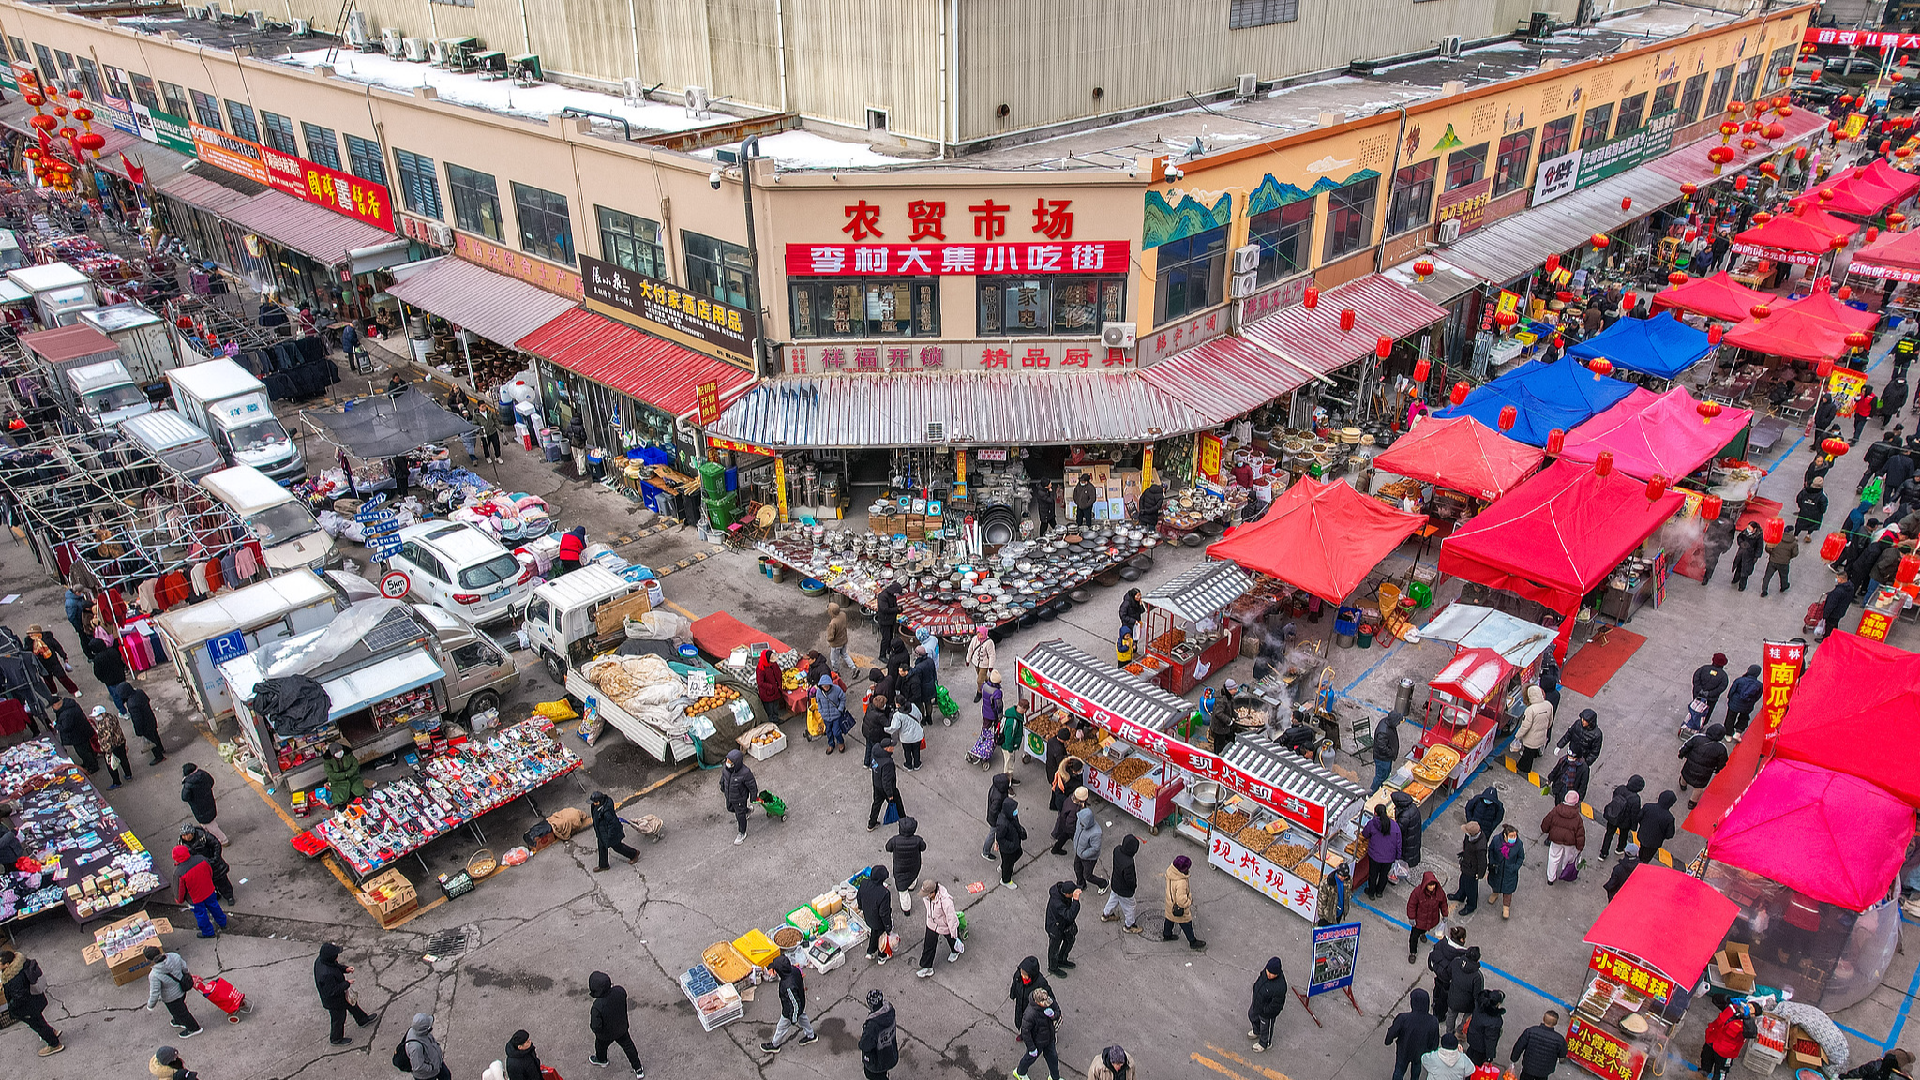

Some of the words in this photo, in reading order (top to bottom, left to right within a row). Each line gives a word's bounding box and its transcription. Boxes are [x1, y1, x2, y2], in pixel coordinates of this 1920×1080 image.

[842, 198, 1074, 242] 农贸市场
[810, 244, 1105, 273] 李村大集小吃街
[639, 279, 744, 333] 大付家酒店用品
[821, 346, 944, 368] 祥福开锁
[980, 348, 1133, 369] 精品厨具
[701, 394, 716, 406] 开锁
[217, 637, 231, 655] P
[1769, 647, 1801, 660] 桂林
[1088, 767, 1143, 814] 岛脂渣
[1189, 753, 1311, 819] 现炸现卖
[1213, 838, 1314, 912] 现炸现卖
[1568, 1038, 1633, 1080] 就是这个味
